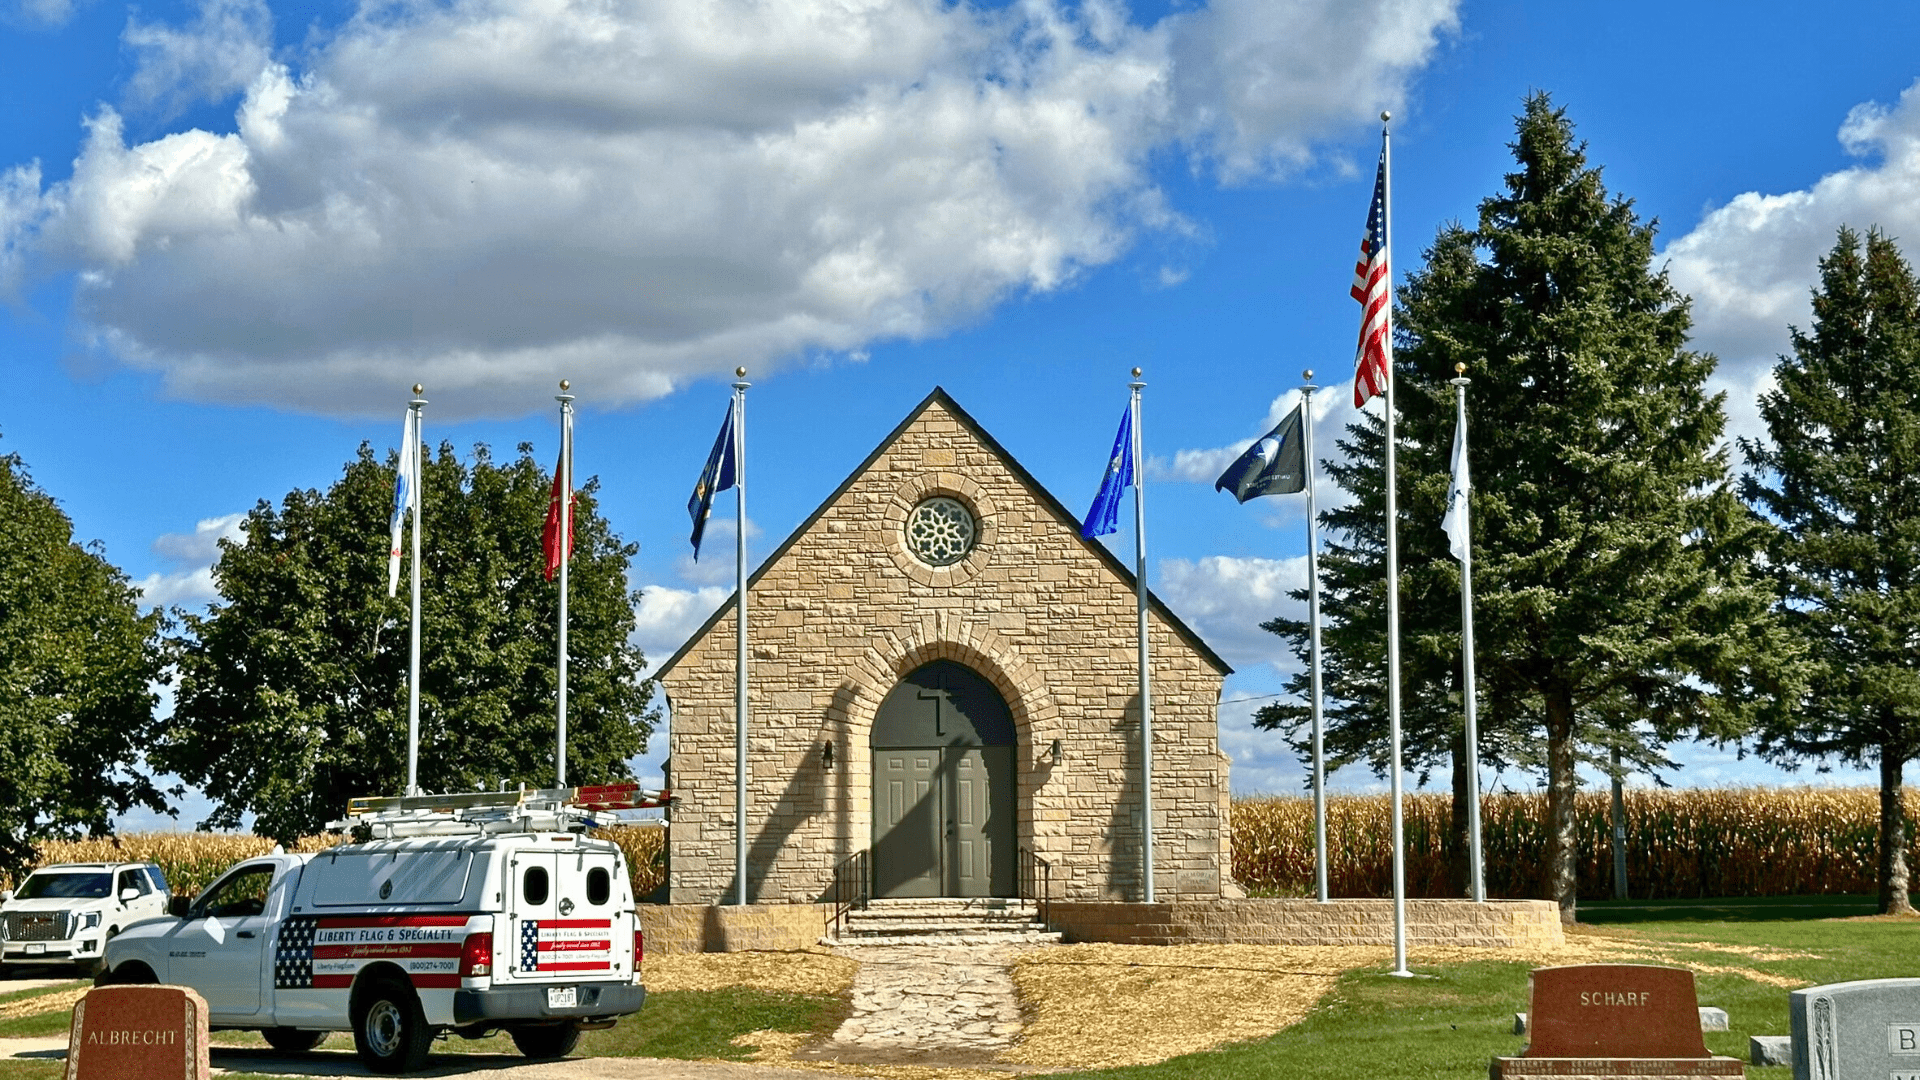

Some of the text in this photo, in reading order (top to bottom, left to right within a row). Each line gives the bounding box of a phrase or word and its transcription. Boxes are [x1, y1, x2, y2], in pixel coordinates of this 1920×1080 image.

[318, 928, 453, 942] LIBERTY FLAG & SPECIALTY
[1581, 992, 1650, 1006] SCHARF
[88, 1030, 178, 1045] ALBRECHT
